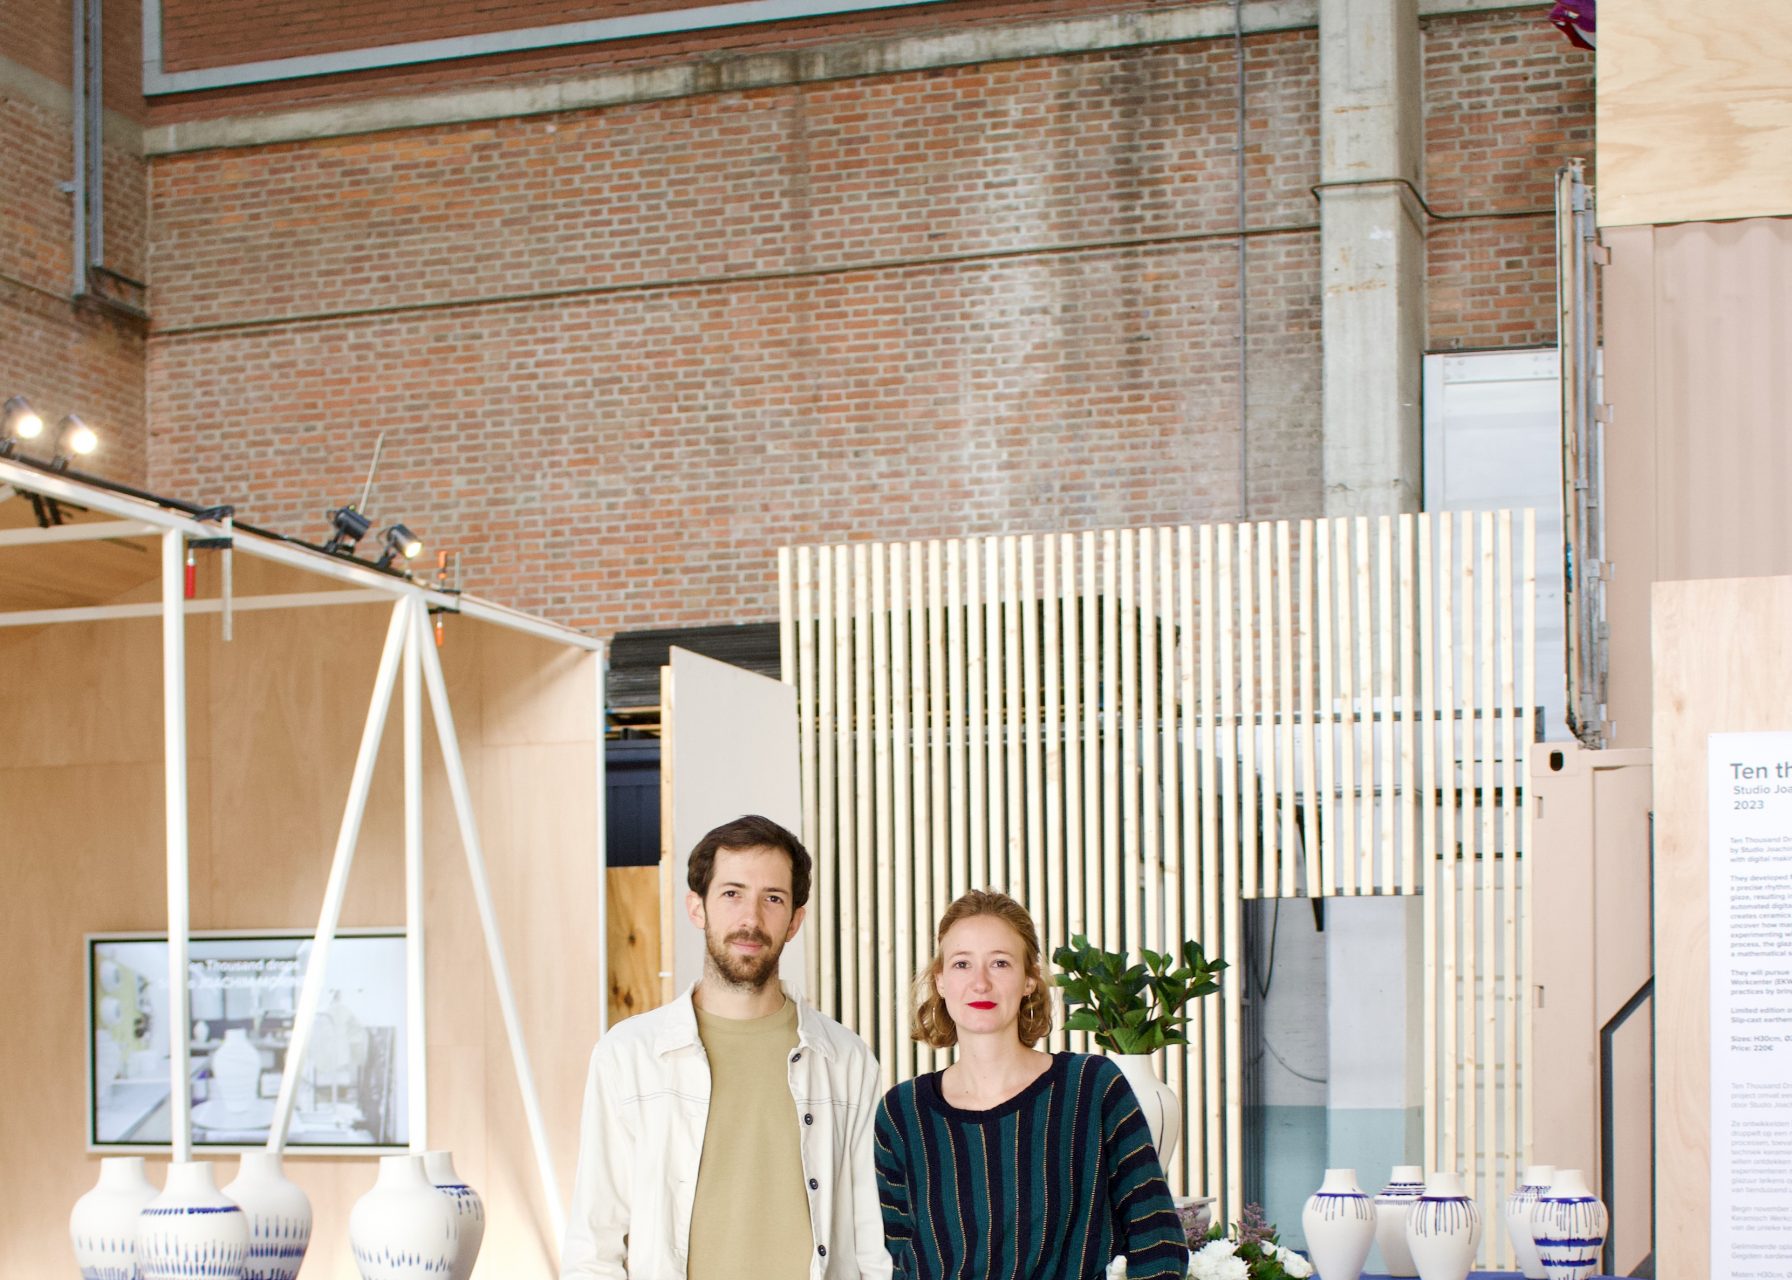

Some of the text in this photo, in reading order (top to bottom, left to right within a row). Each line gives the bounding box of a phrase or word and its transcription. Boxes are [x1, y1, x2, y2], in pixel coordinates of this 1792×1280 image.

[1730, 762, 1768, 779] Ten
[1734, 785, 1771, 795] Studio
[1734, 799, 1764, 810] 2023
